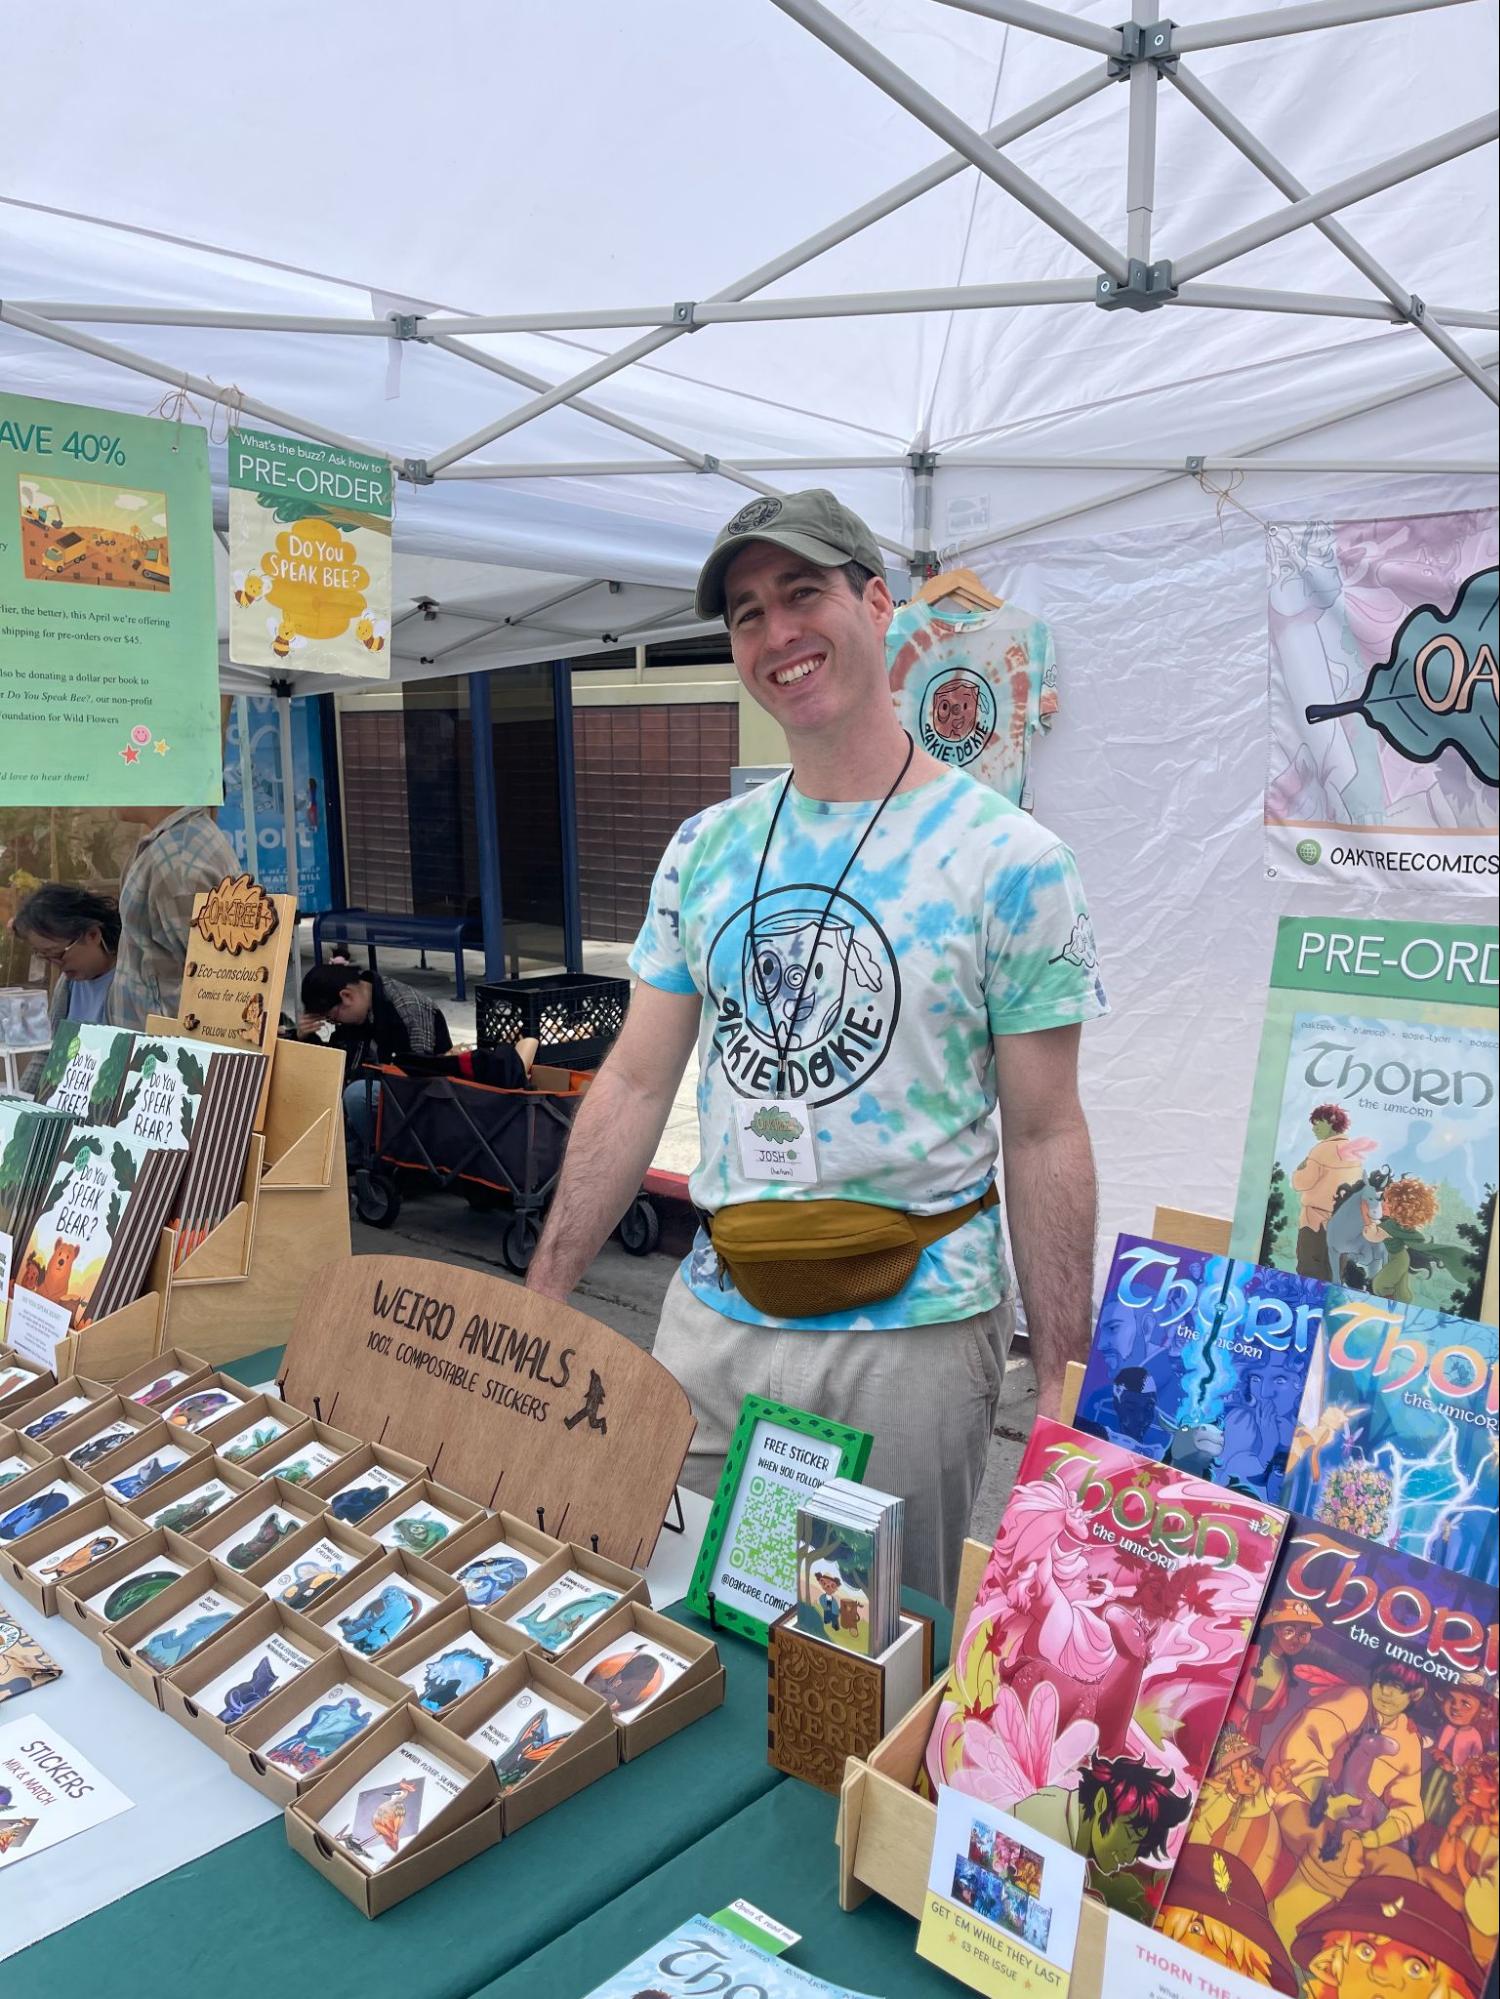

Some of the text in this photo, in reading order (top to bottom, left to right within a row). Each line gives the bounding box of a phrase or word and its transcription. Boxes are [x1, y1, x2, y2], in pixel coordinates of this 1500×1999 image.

[0, 420, 126, 466] AVE 40%
[239, 434, 382, 474] What's the buzz? Ask how to
[239, 454, 383, 506] PRE-ORDER
[270, 554, 360, 588] SPEAK BEE?
[21, 606, 35, 616] the
[38, 607, 69, 619] better),
[71, 610, 87, 620] this
[89, 612, 110, 623] April
[113, 615, 137, 624] we're
[138, 616, 170, 628] offering
[1, 627, 142, 645] shipping for pre-orders over $45.
[16, 669, 26, 678] be
[29, 670, 67, 682] donating
[76, 672, 100, 682] dollar
[103, 676, 116, 685] per
[119, 675, 138, 685] book
[7, 690, 21, 700] Do
[24, 691, 39, 700] You
[42, 691, 67, 702] Speak
[112, 695, 152, 706] non-profit
[49, 713, 60, 721] for
[62, 713, 84, 723] Wild
[86, 714, 119, 724] Flowers
[10, 772, 28, 781] love
[30, 773, 39, 781] to
[41, 773, 61, 782] hear
[64, 773, 89, 782] them!
[197, 964, 259, 982] Eco-conscious
[197, 988, 221, 1002] Comics
[223, 990, 234, 1002] for
[201, 1025, 226, 1039] FOLLOW
[63, 1068, 94, 1092] SPEAK
[57, 1090, 88, 1113] TREE?
[142, 1089, 176, 1117] SPEAK
[1358, 1098, 1433, 1118] the unicorn
[134, 1113, 173, 1144] BEAR?
[759, 1150, 785, 1163] JOSH
[68, 1181, 105, 1211] SPEAK
[56, 1206, 98, 1241] BEAR?
[372, 1279, 576, 1388] WEIRD ANIMALS
[1177, 1324, 1263, 1360] the nicorn
[366, 1330, 550, 1422] 100% COMPOSTABLE STICKERS
[1403, 1391, 1499, 1431] the unicor
[763, 1437, 788, 1456] FREE
[757, 1457, 778, 1473] WHEN
[795, 1472, 825, 1489] FOLLOW
[1092, 1519, 1272, 1572] the unicorn #2
[1350, 1624, 1460, 1685] the unicorn
[783, 1678, 876, 1736] BOOK
[783, 1703, 869, 1757] NERD
[2, 1758, 58, 1806] MIX & MATCH
[20, 1740, 94, 1798] STICKERS
[734, 1900, 755, 1918] Open
[755, 1914, 763, 1923] &
[763, 1918, 783, 1934] read
[931, 1901, 1062, 1987] GET 'EM WHILE THEY LAST
[961, 1940, 1017, 1981] $3 PER ISSUE
[1136, 1944, 1231, 1999] THORN THE
